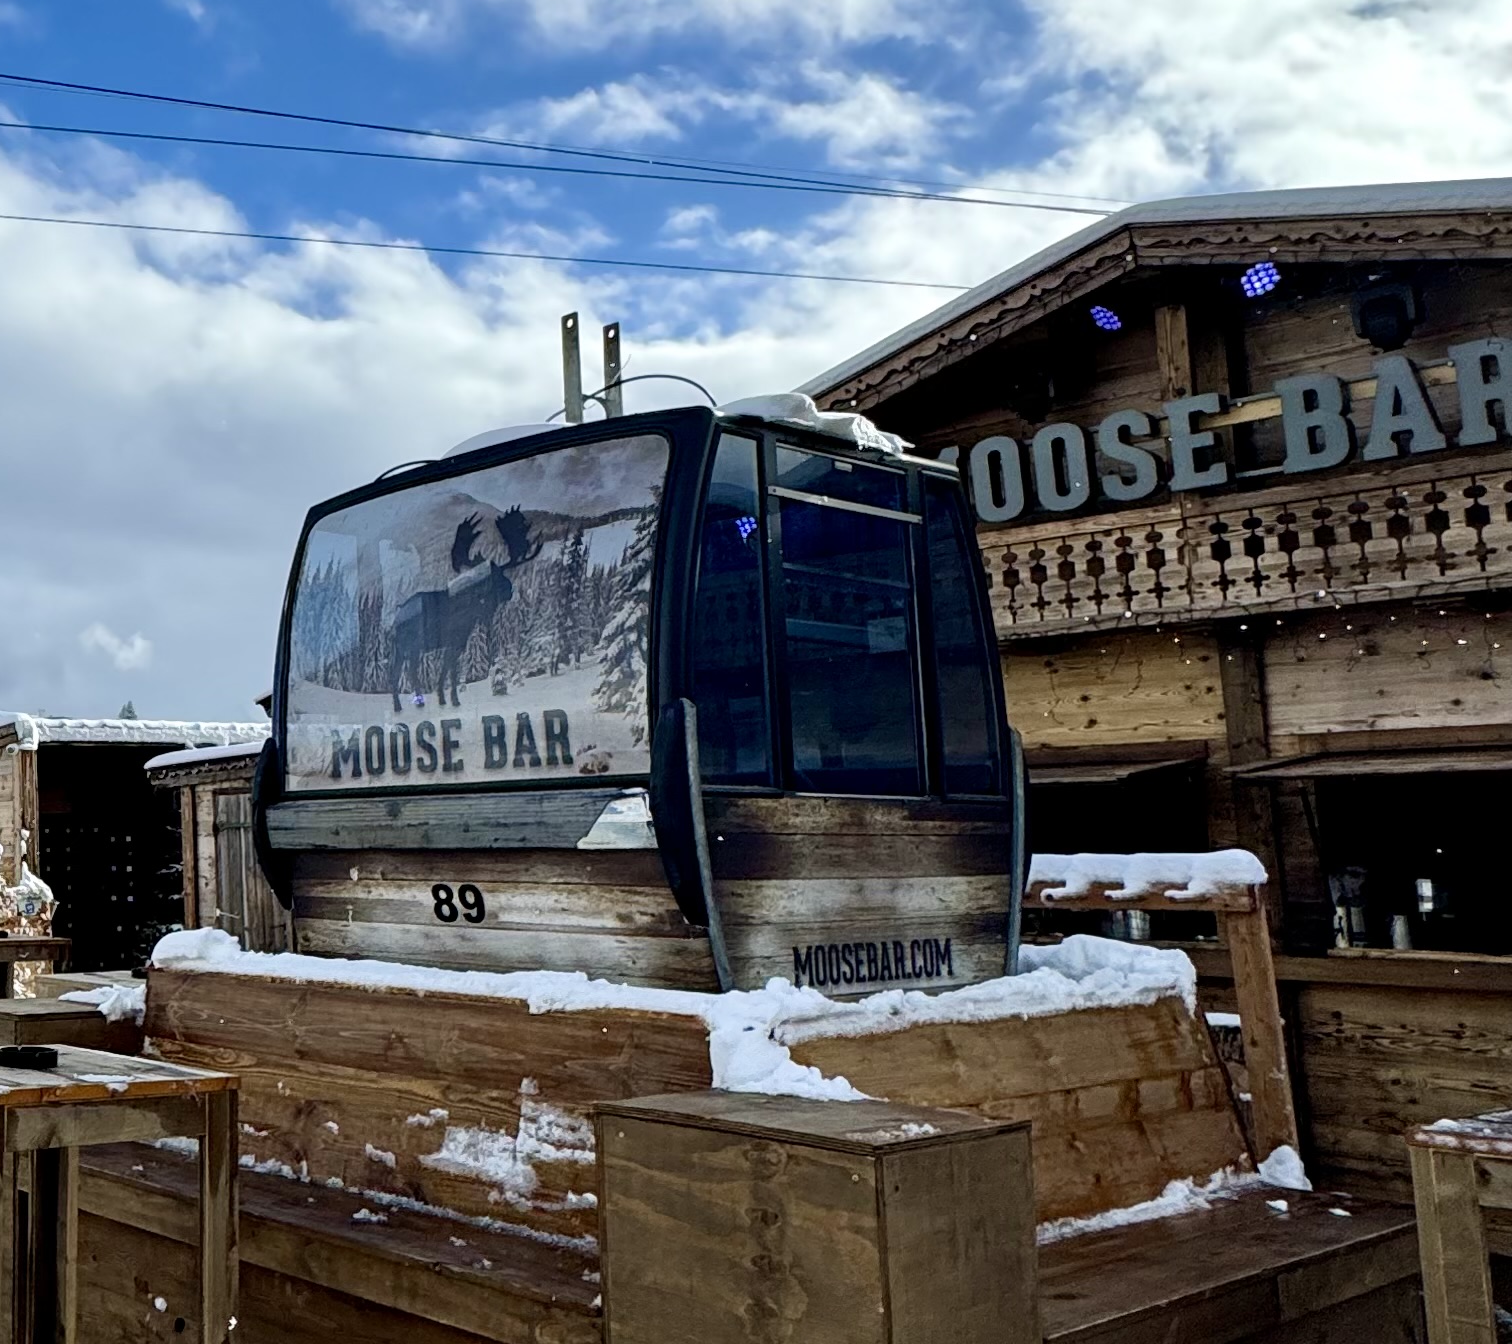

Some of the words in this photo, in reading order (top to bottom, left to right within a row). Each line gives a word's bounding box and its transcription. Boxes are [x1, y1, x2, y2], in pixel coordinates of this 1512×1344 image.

[938, 393, 1228, 522] OOSE
[1274, 337, 1512, 475] BAR
[330, 718, 464, 779] MOOSE
[482, 709, 574, 769] BAR
[431, 883, 486, 924] 89
[792, 938, 953, 989] MOOSEBAR.COM
